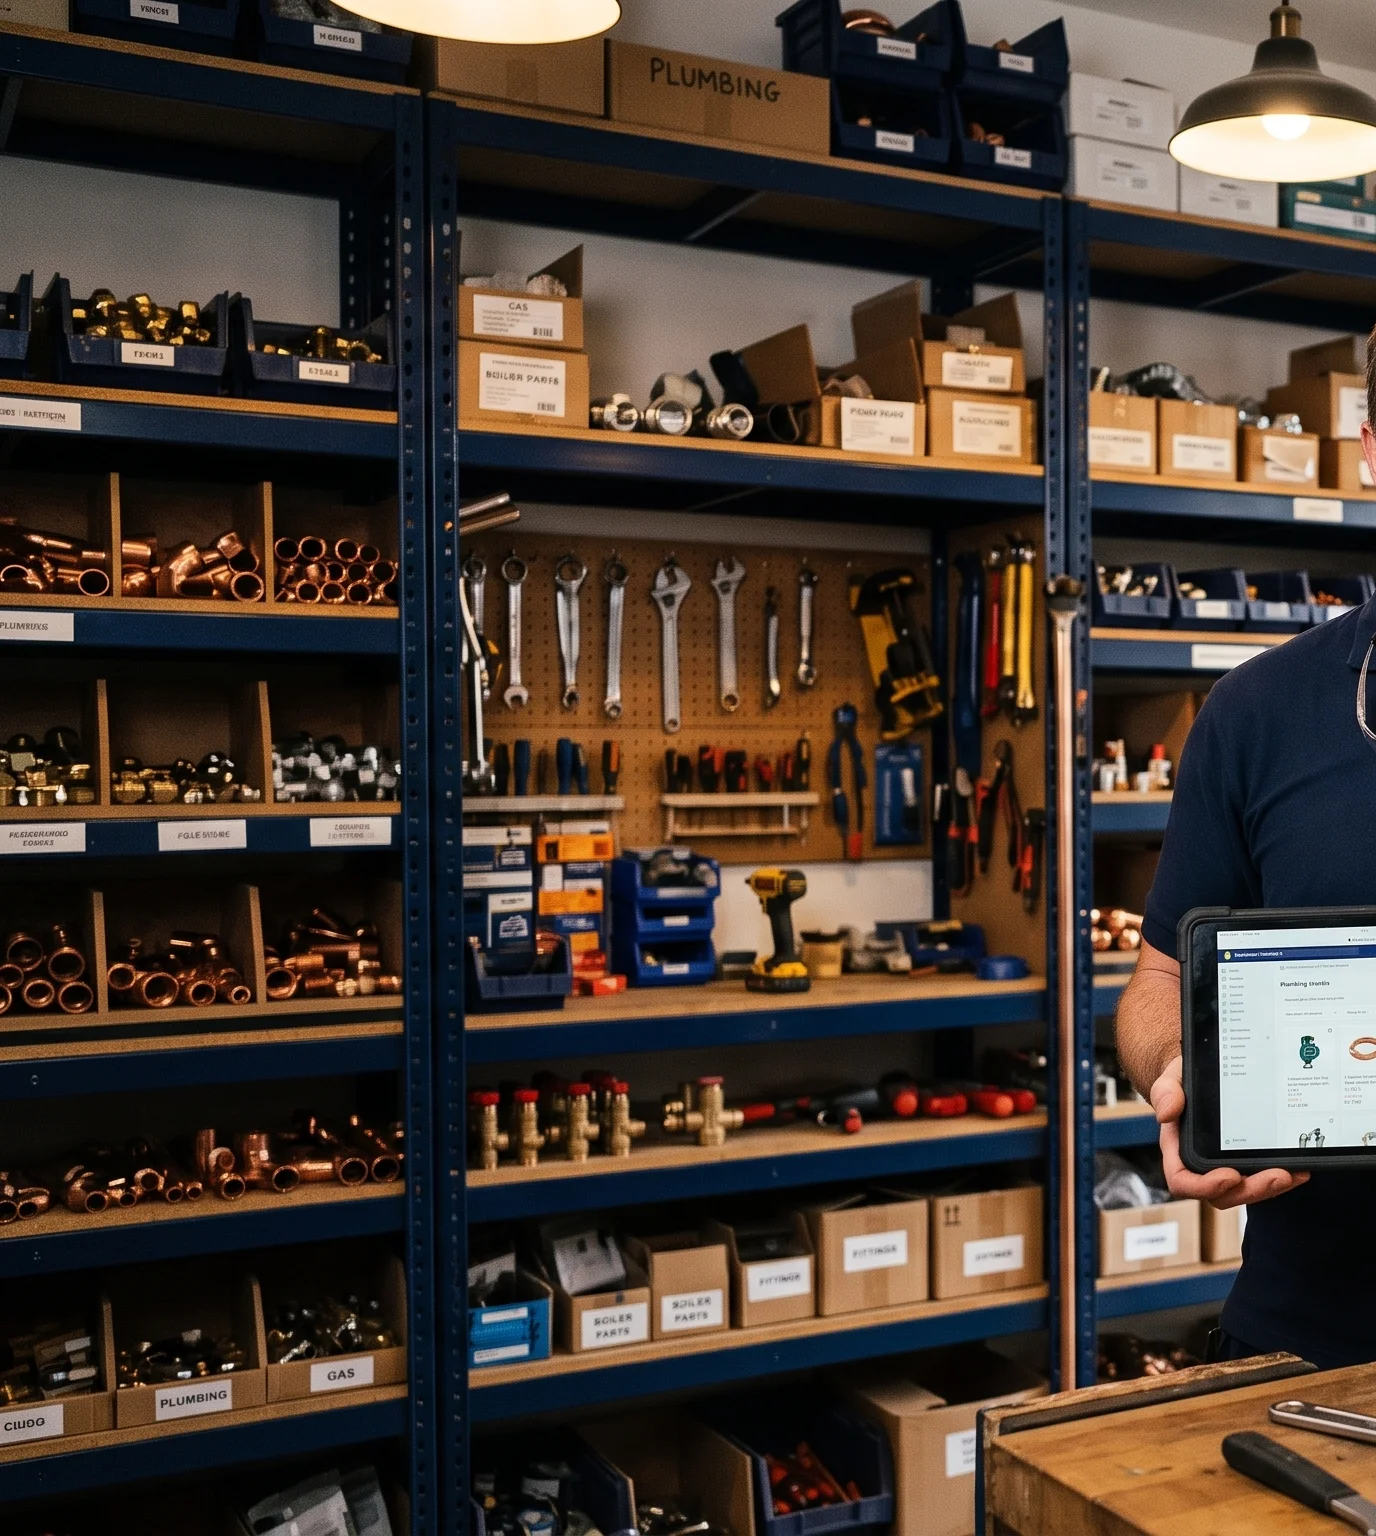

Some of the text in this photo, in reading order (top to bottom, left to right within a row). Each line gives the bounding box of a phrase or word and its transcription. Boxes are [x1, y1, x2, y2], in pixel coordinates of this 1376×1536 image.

[650, 56, 781, 102] PLUMBING
[326, 1368, 356, 1381] GAS
[160, 1390, 228, 1409] PLUMBING
